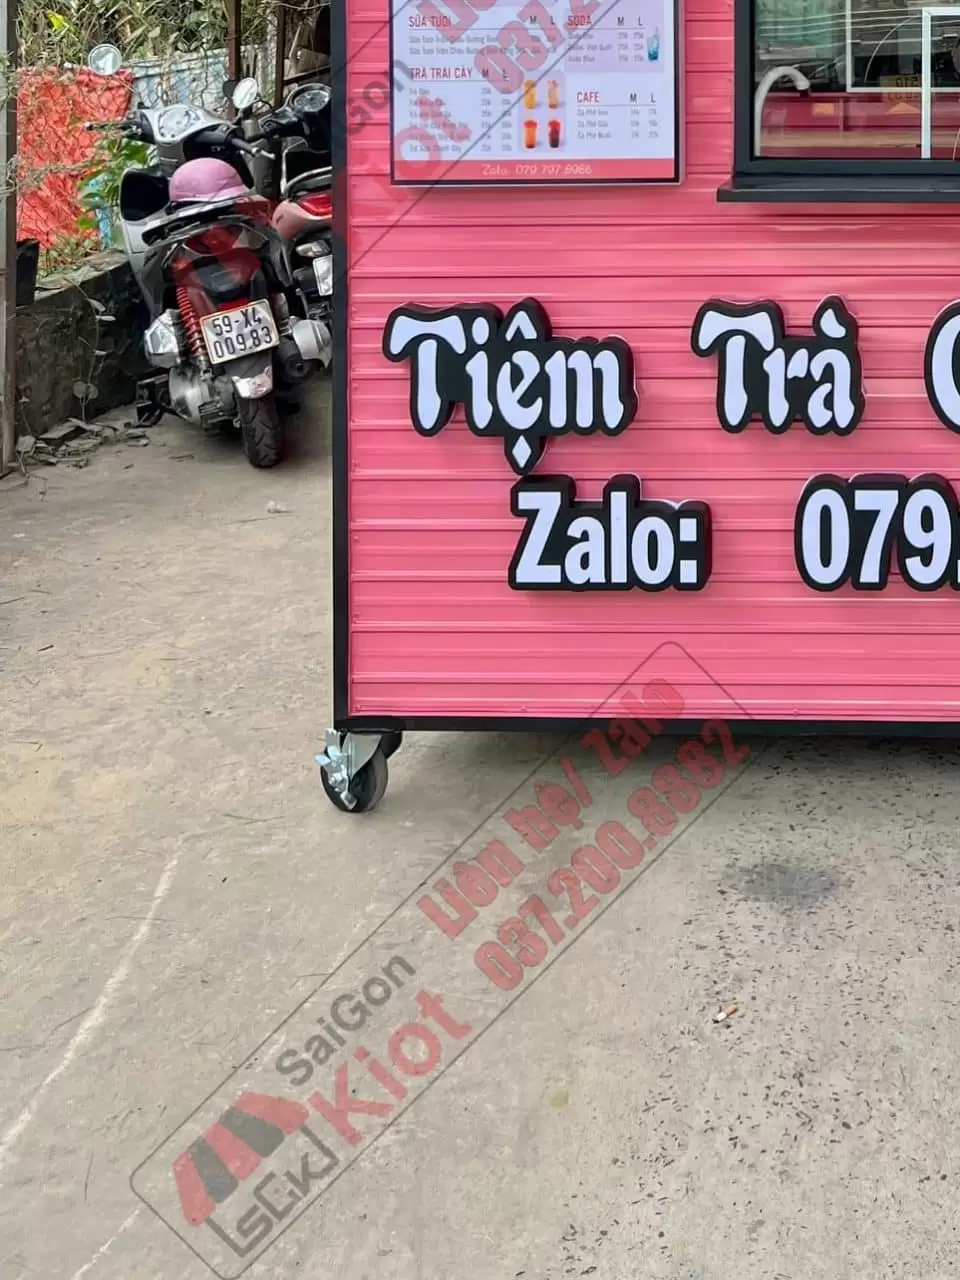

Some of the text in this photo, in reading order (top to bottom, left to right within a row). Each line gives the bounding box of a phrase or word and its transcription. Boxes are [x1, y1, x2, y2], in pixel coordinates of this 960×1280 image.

[567, 15, 644, 27] SODA M L
[629, 92, 637, 103] M
[650, 92, 657, 103] L
[212, 306, 262, 337] 59-X4
[213, 326, 273, 359] 009.83
[388, 308, 625, 469] Tiệm
[698, 306, 856, 429] Trà
[515, 490, 698, 585] Zalo:
